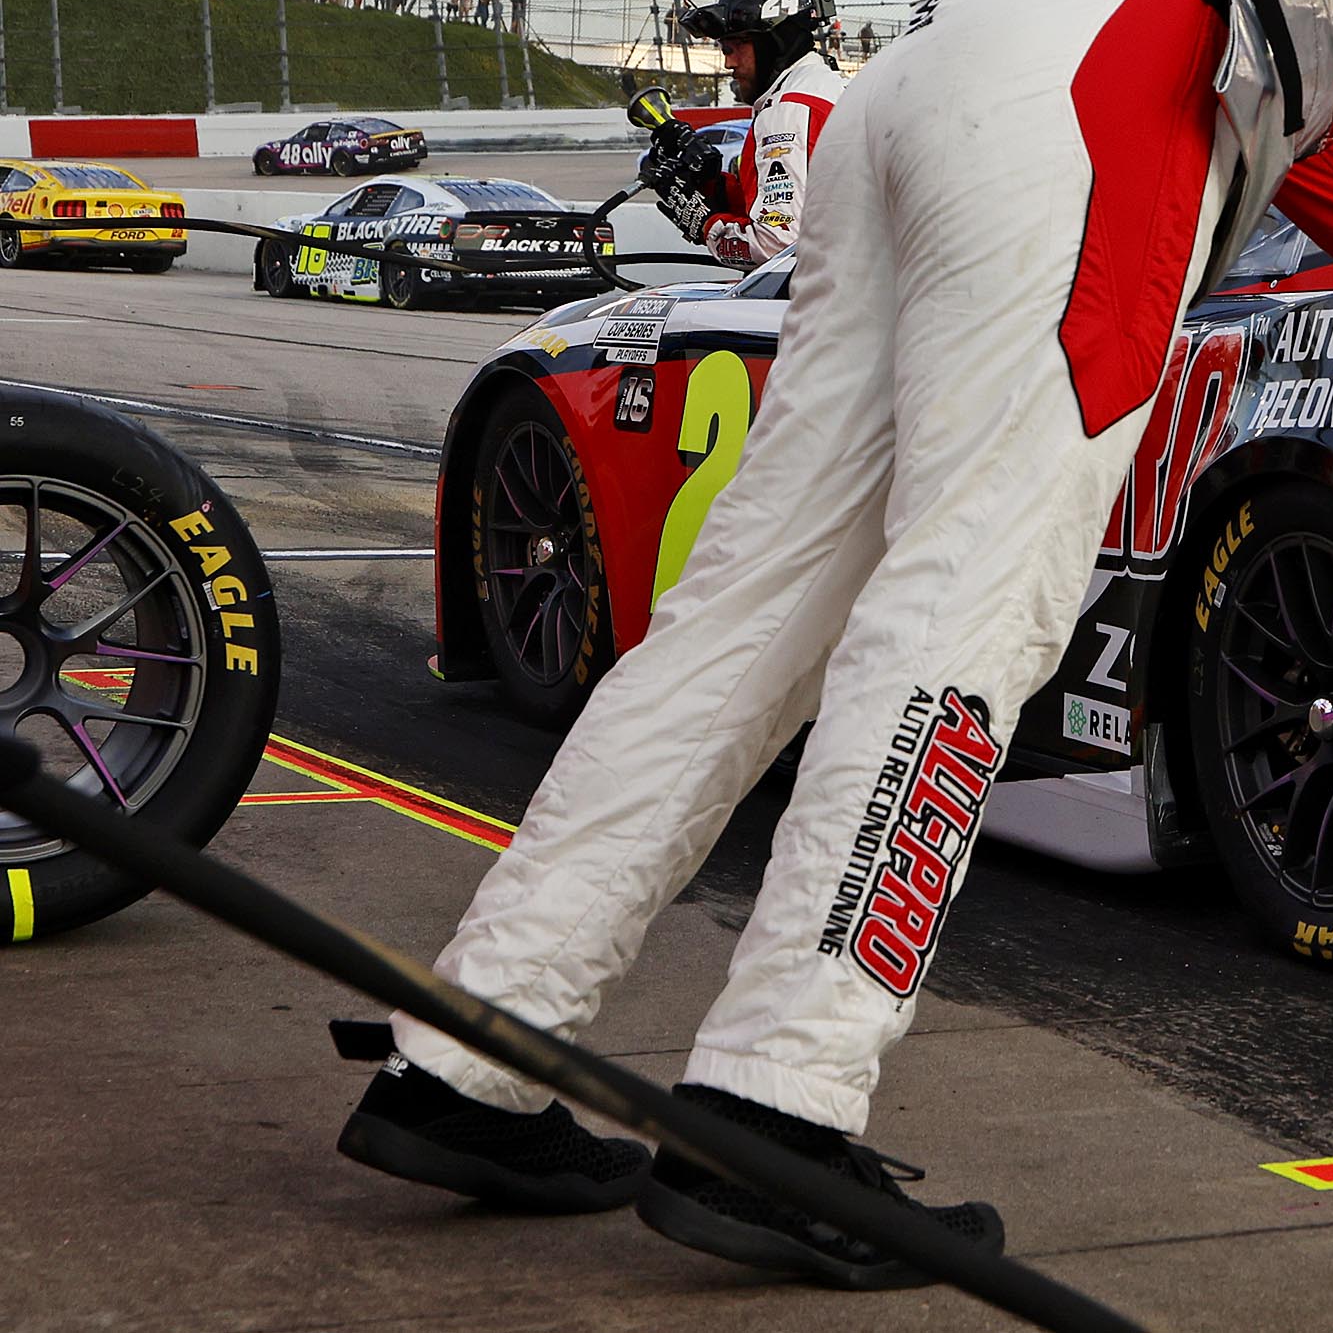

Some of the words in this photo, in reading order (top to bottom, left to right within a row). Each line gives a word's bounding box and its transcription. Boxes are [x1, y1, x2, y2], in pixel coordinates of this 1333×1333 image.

[390, 136, 411, 151] ally
[279, 143, 300, 165] 48
[302, 141, 333, 168] ally
[762, 191, 794, 205] CLIMB
[110, 230, 146, 240] FORD
[396, 215, 442, 235] TIRE
[297, 224, 333, 276] 16
[481, 239, 561, 253] BLACK'S
[627, 300, 667, 315] NASCAR
[607, 322, 627, 337] CUP
[625, 322, 656, 338] SERIES
[615, 349, 648, 362] PLAYOFFS
[619, 376, 653, 423] 16
[9, 416, 25, 427] 55
[1195, 499, 1256, 633] EAGLE
[169, 510, 258, 676] EAGLE
[891, 685, 935, 756] AUTO
[852, 688, 1001, 997] ALL-PRO
[817, 753, 909, 959] RECONDITIONING
